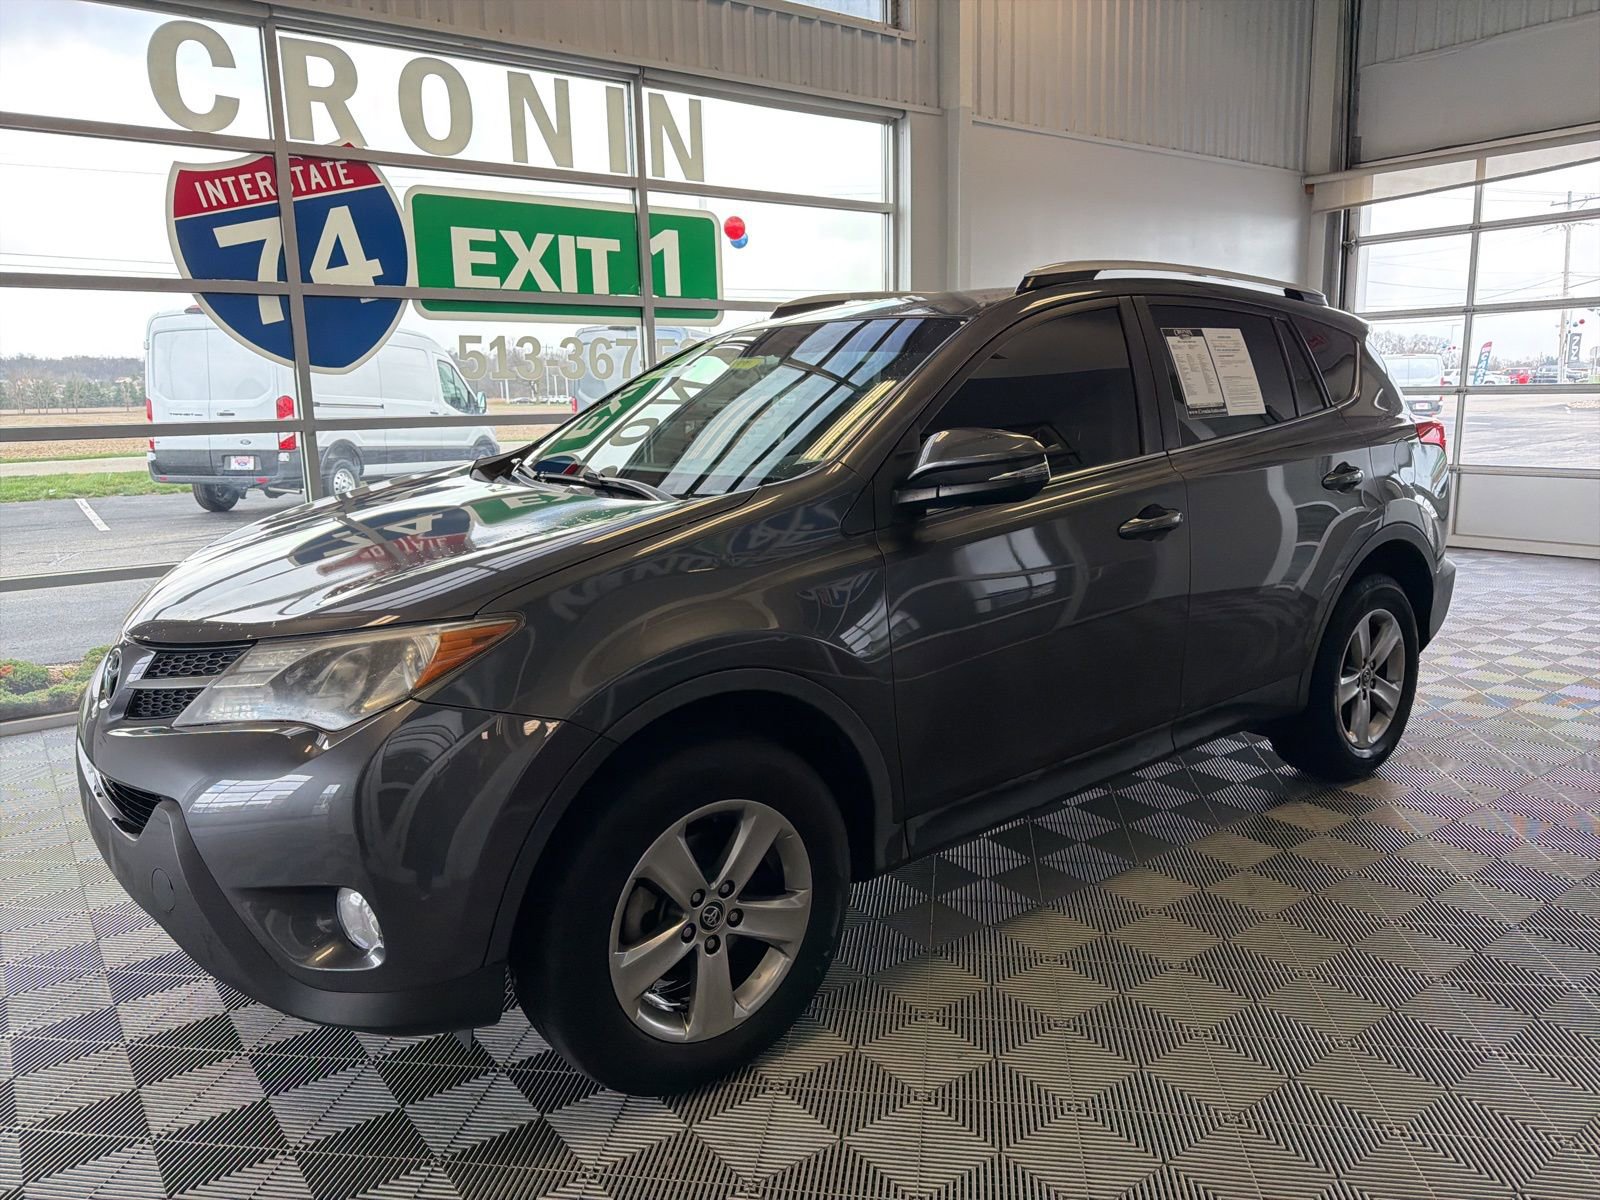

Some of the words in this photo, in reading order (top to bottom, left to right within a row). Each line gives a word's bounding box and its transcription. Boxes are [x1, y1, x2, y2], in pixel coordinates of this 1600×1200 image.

[147, 20, 704, 183] CRONIN
[194, 160, 354, 208] INTERTATE
[213, 205, 384, 325] 74
[450, 226, 621, 295] EXIT
[650, 229, 682, 297] 1
